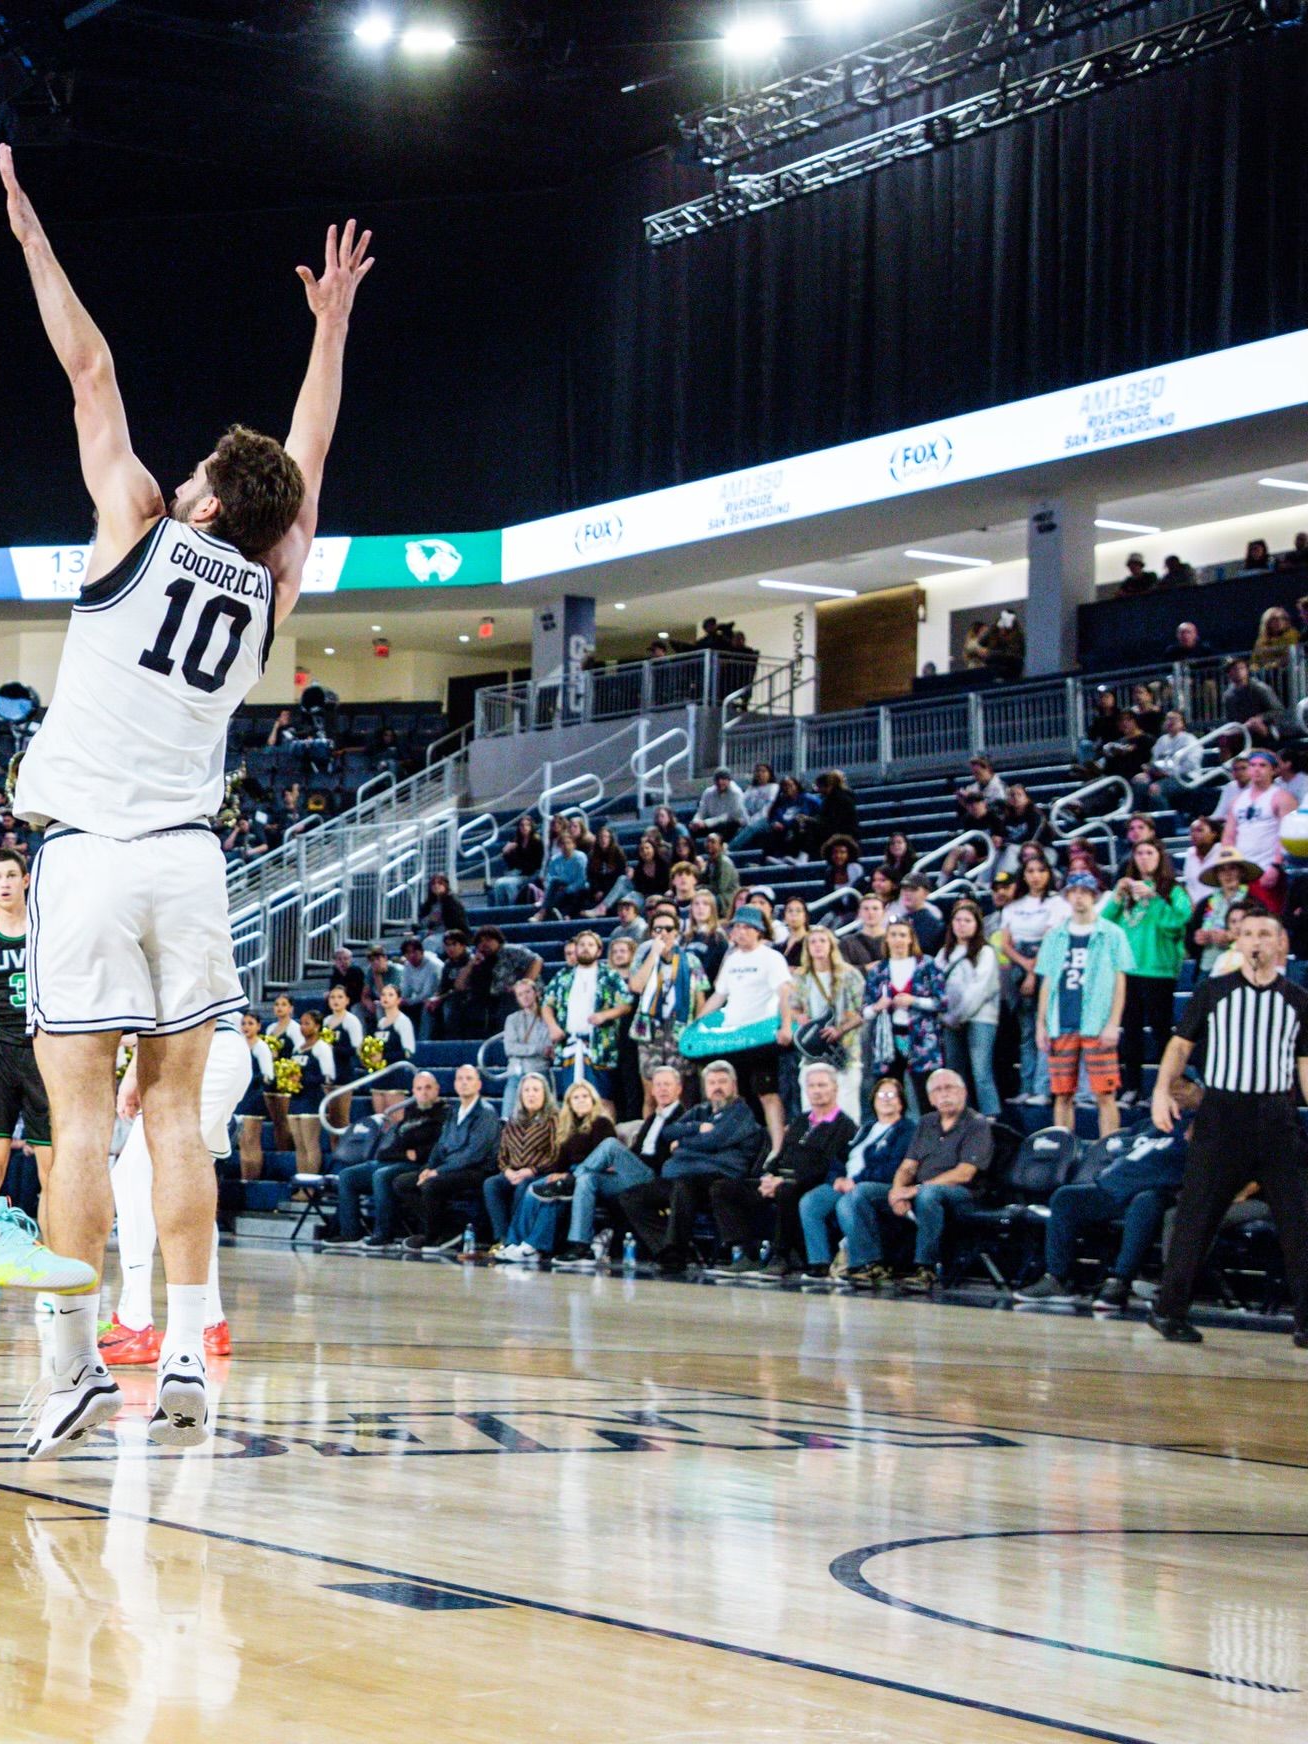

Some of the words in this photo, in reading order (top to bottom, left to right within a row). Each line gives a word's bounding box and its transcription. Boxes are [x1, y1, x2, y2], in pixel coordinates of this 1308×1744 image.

[903, 440, 938, 468] FOX
[584, 520, 611, 542] FOX
[52, 550, 84, 573] 13
[170, 542, 265, 600] GOODRICK
[138, 577, 252, 693] 10
